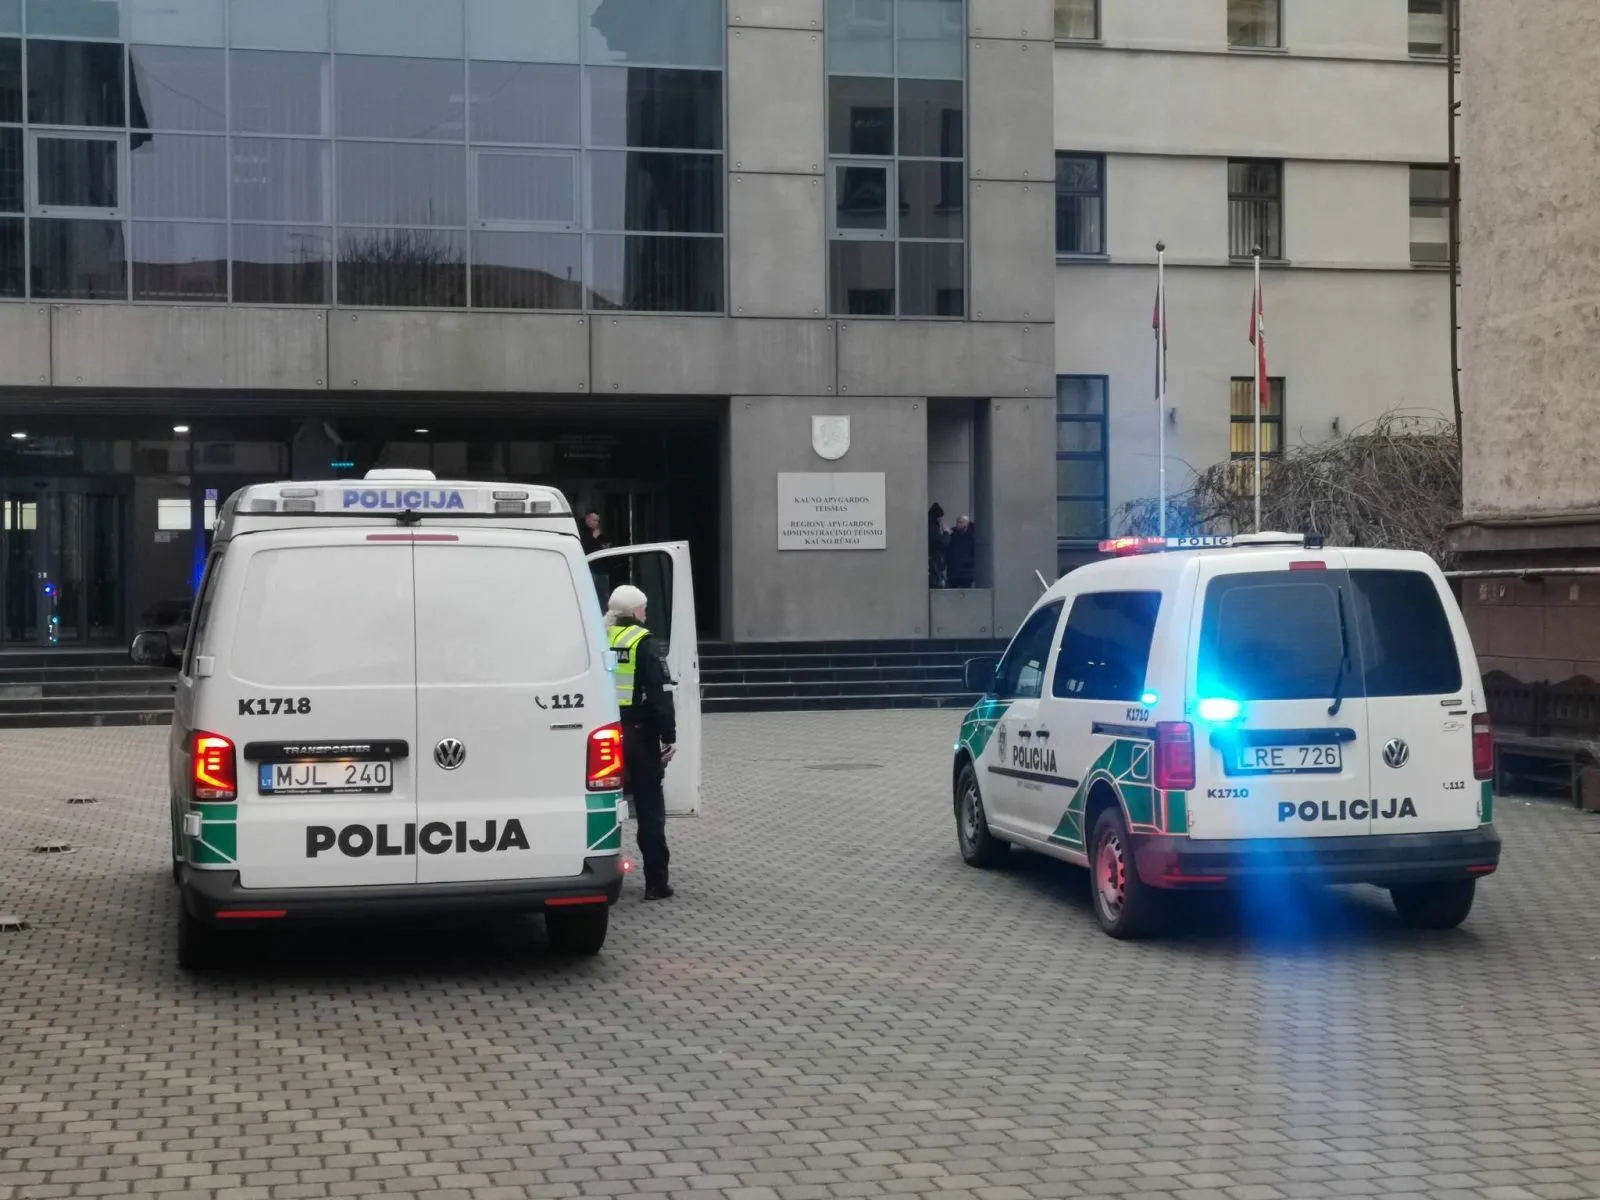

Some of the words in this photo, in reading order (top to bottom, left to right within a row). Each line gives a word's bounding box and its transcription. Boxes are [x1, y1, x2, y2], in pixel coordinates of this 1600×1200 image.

[343, 489, 464, 509] POLICIJA
[794, 496, 822, 504] KAUNO
[824, 496, 870, 504] APYGARDOS
[1178, 537, 1228, 546] POLIC
[238, 698, 311, 715] K1718
[552, 693, 584, 709] 112
[283, 745, 371, 754] TRANSPORTER
[1241, 748, 1285, 767] LRE
[1299, 747, 1336, 765] 726
[1013, 745, 1057, 773] POLICIJA
[276, 765, 327, 786] MJL
[345, 763, 386, 784] 240
[1207, 789, 1249, 798] K1710
[1449, 782, 1465, 790] 112
[1278, 798, 1417, 822] POLICIJA
[306, 819, 530, 857] POLICIJA
